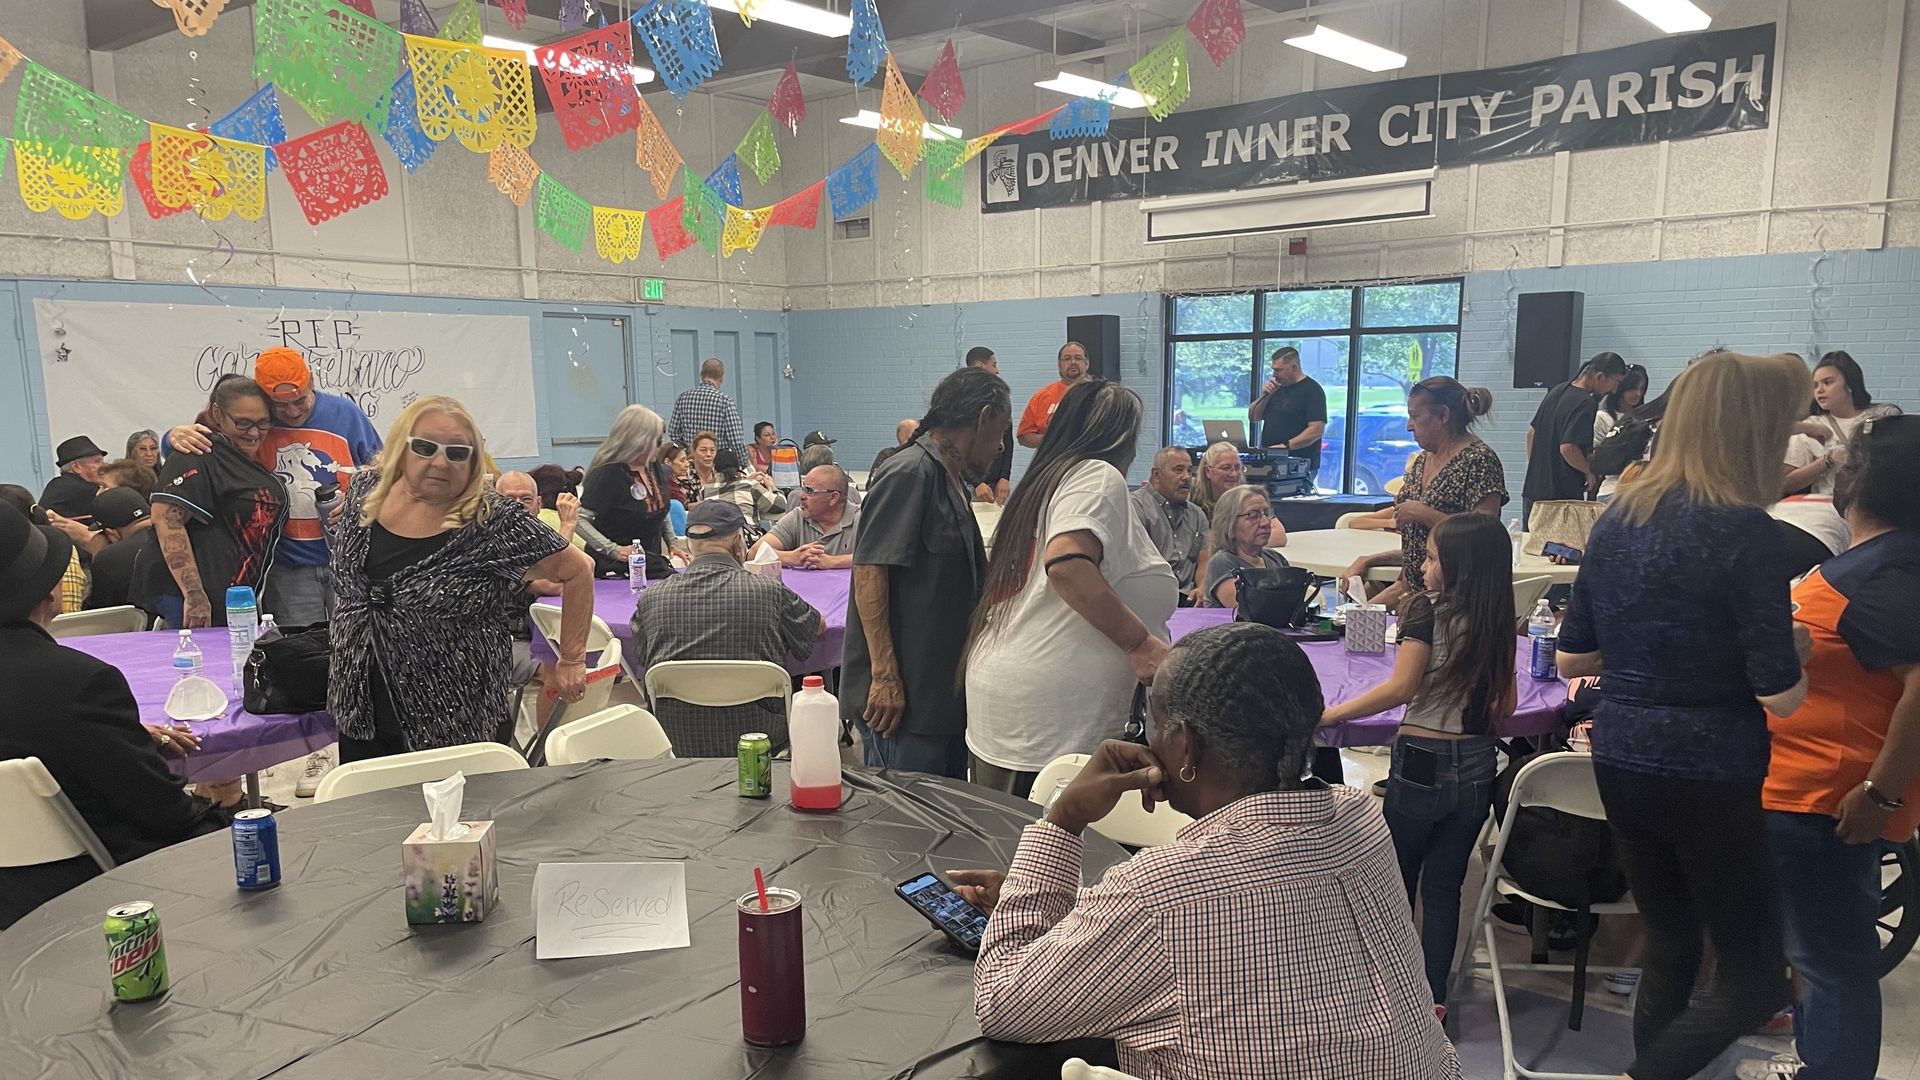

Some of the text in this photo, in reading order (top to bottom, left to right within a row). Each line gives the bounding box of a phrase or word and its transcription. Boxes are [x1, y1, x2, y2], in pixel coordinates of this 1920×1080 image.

[1026, 54, 1765, 187] DENVER INNER CITY PARISH
[644, 279, 664, 299] EXIT
[281, 319, 353, 350] RIP
